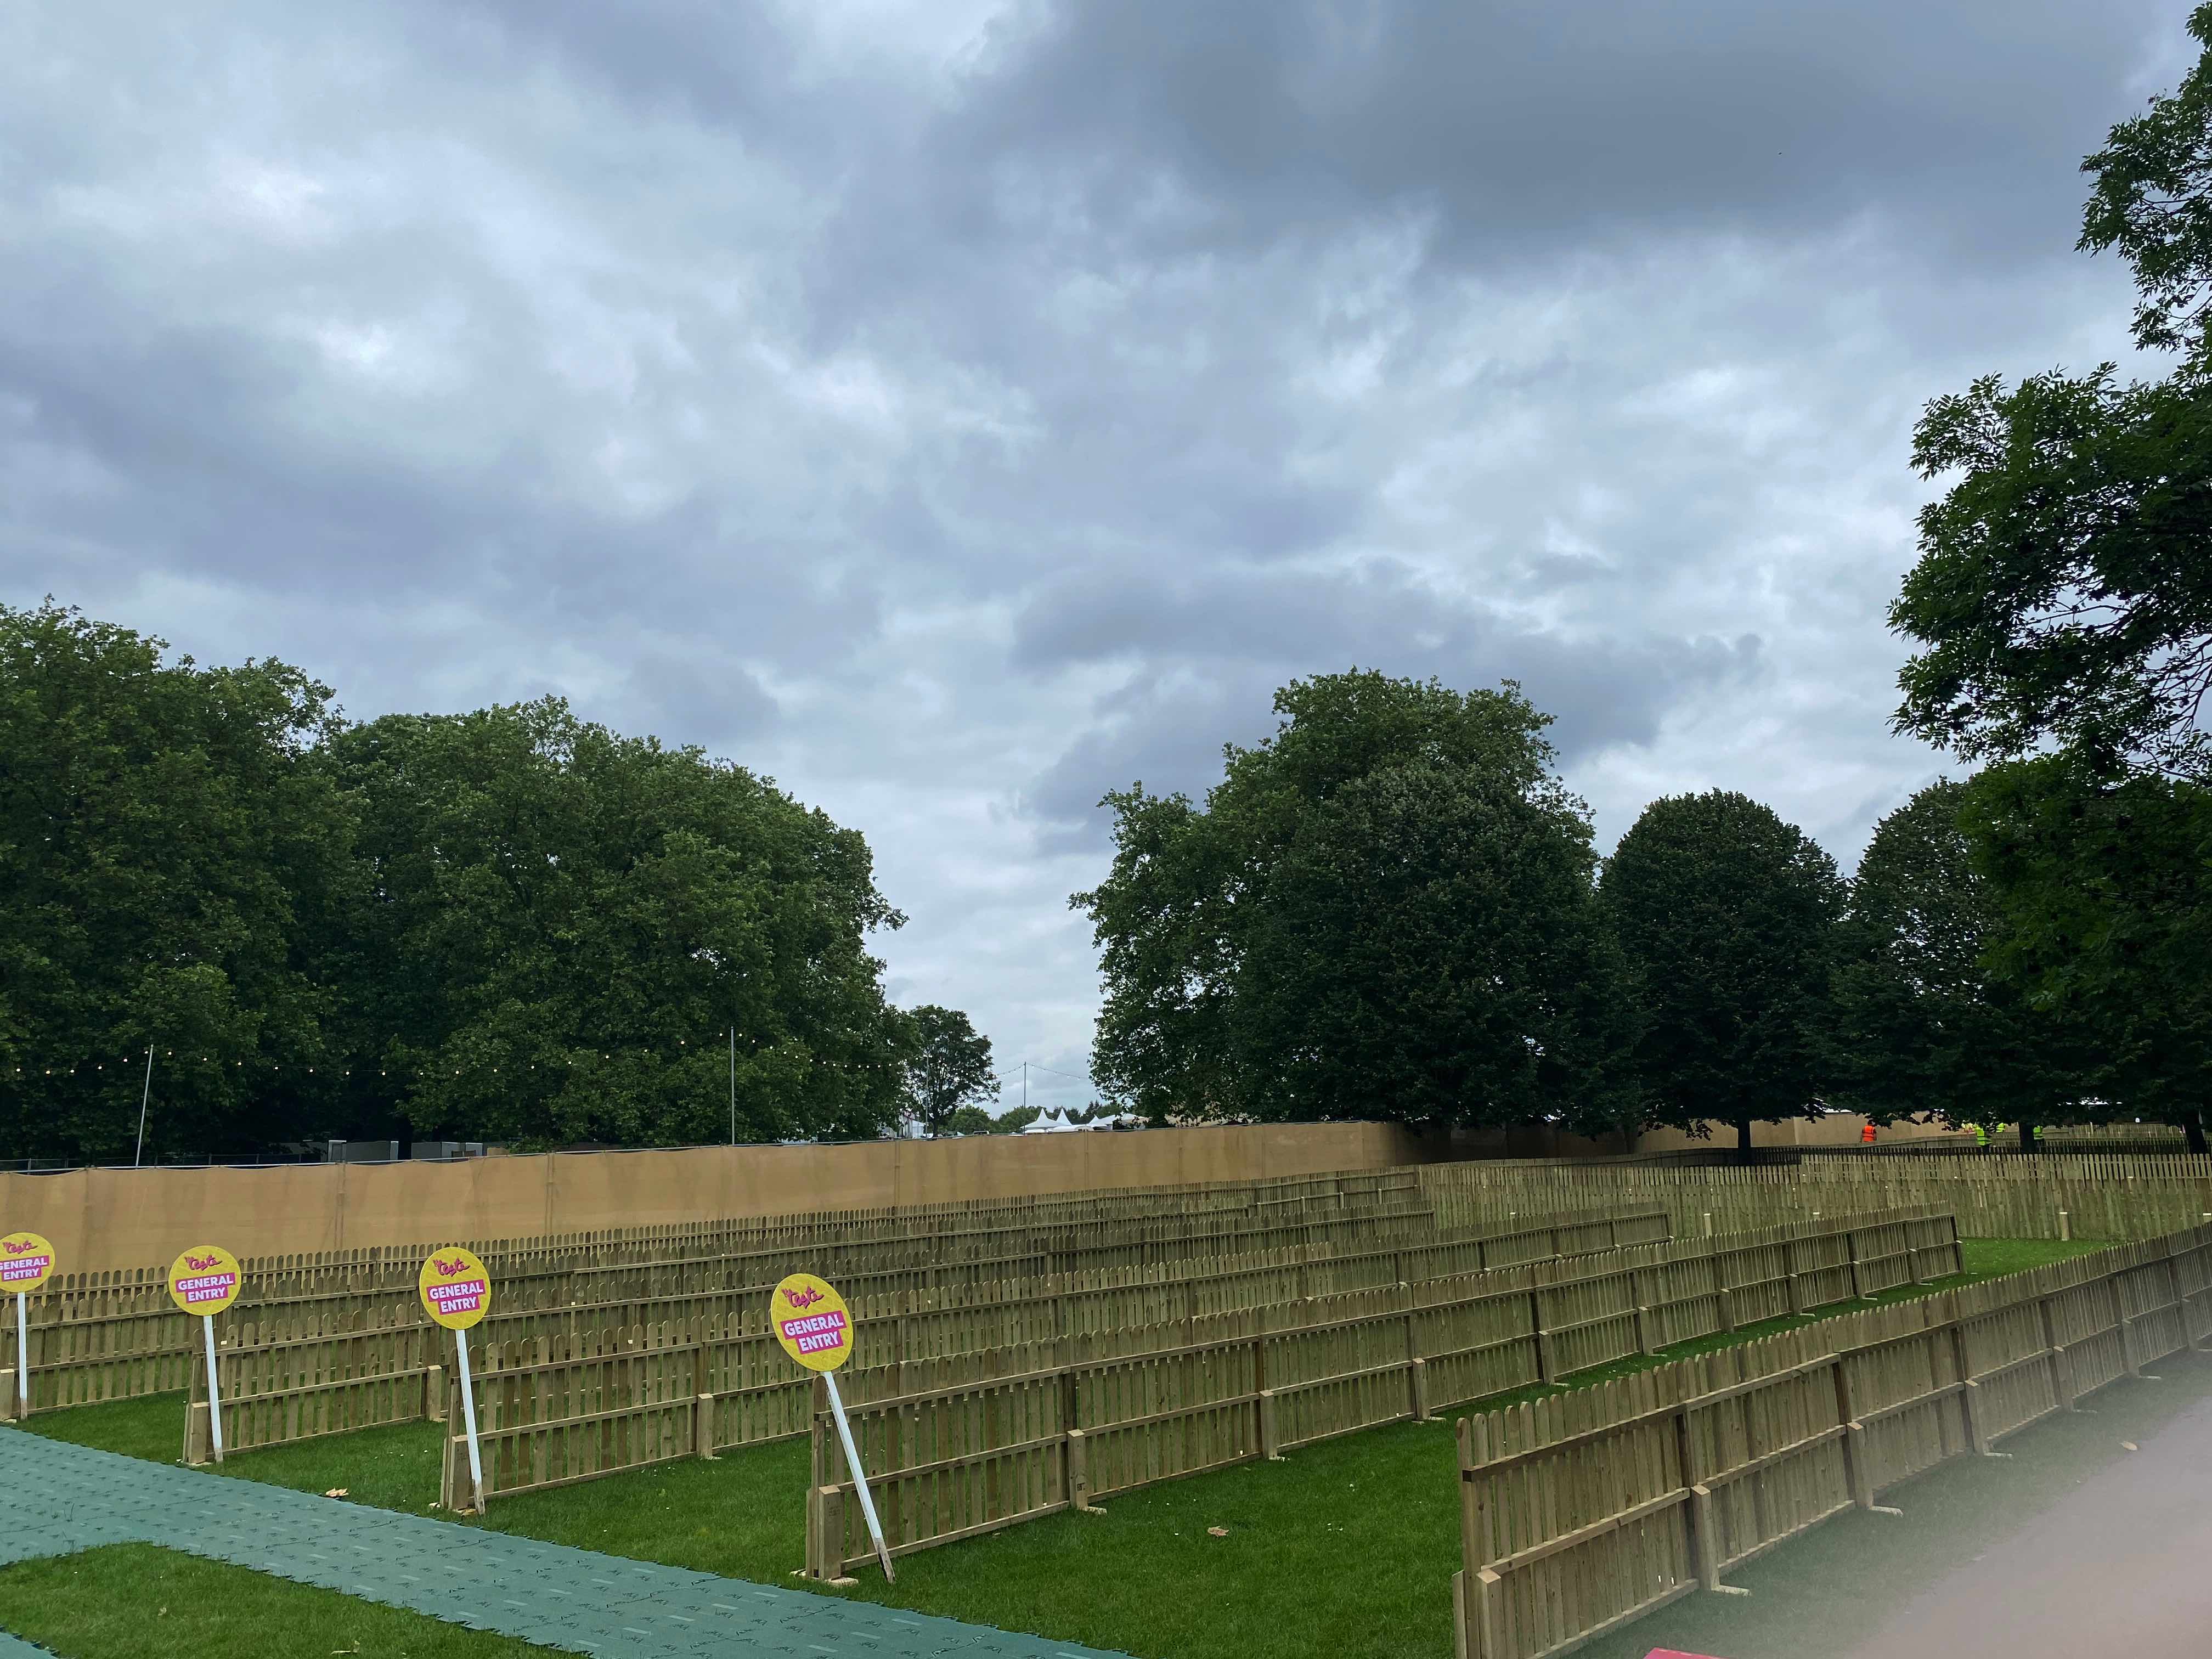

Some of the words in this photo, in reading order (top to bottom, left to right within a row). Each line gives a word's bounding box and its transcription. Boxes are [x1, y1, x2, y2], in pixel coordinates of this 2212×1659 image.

[4, 1268, 39, 1280] ENTRY
[178, 1274, 234, 1290] GENERAL
[188, 1288, 225, 1301] ENTRY
[430, 1282, 483, 1299] GENERAL
[441, 1296, 476, 1312] ENTRY
[785, 1314, 844, 1336] GENERAL
[799, 1331, 839, 1351] ENTRY
